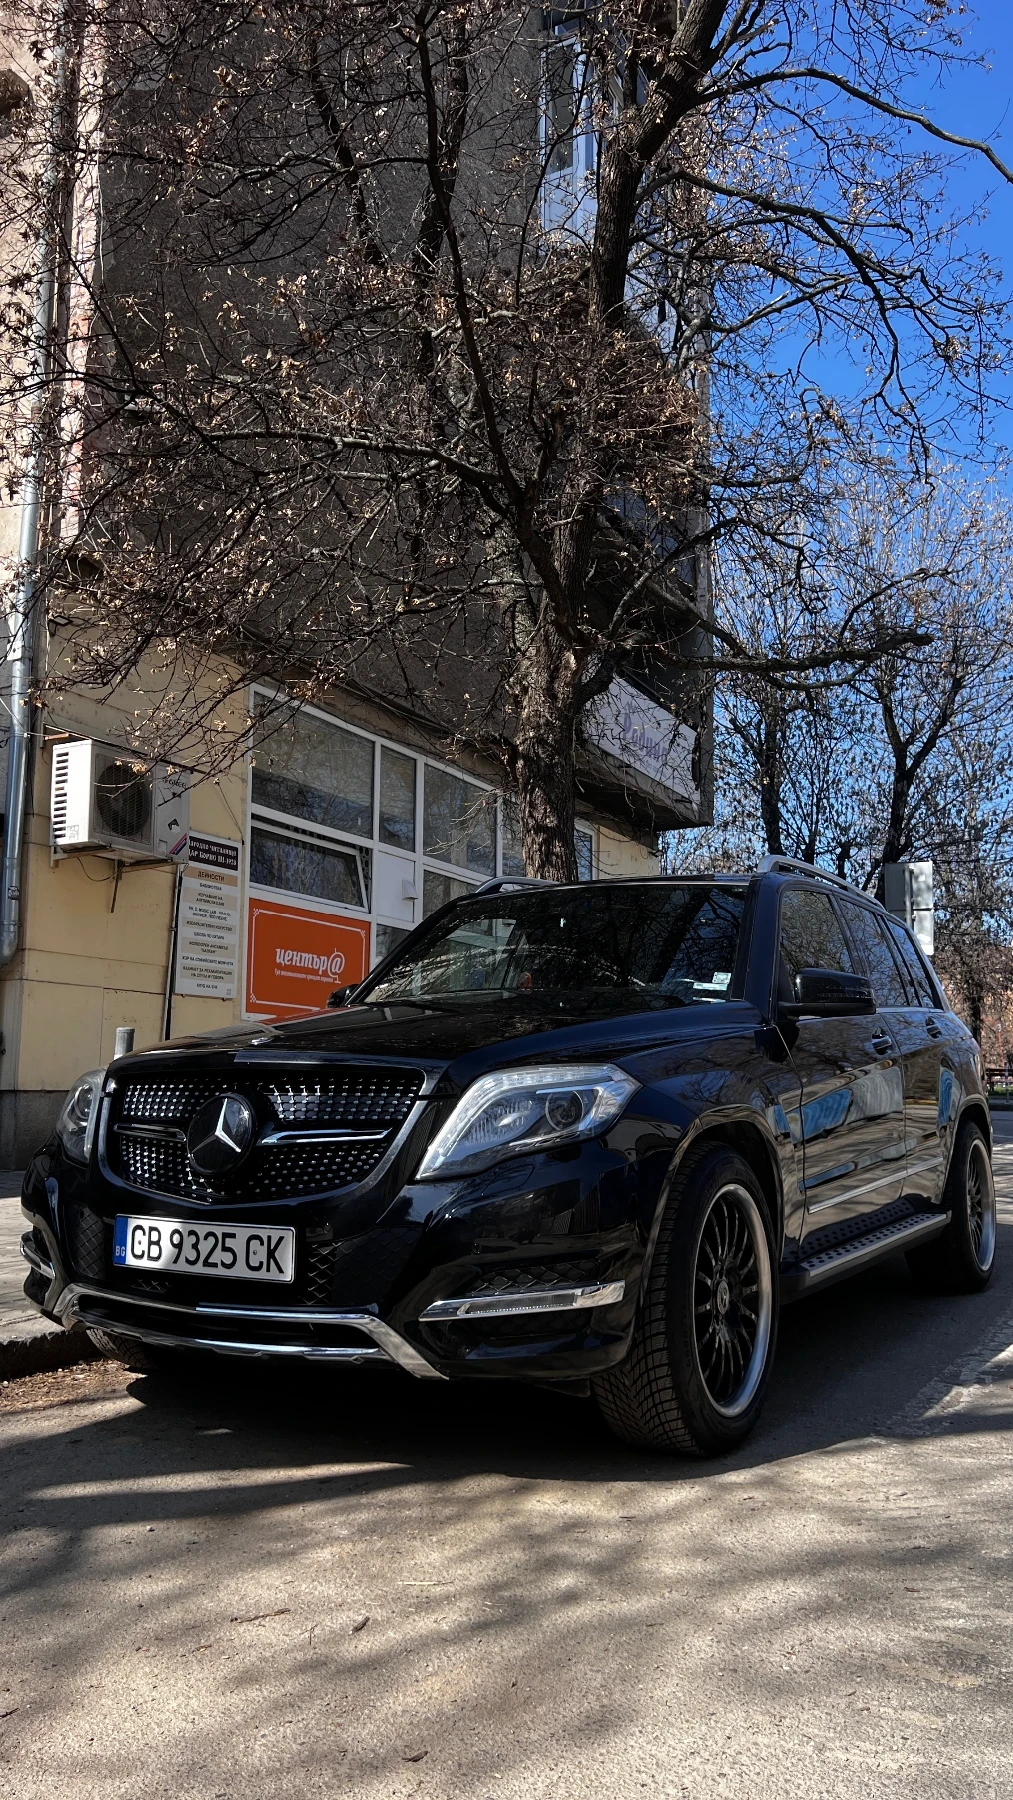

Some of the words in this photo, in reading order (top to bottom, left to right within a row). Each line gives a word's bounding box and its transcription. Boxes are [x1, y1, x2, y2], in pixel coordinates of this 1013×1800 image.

[197, 871, 225, 881] ДЕЙНОСТИ
[115, 1246, 126, 1257] BG
[131, 1225, 162, 1261] CB
[170, 1228, 237, 1269] 9325
[245, 1234, 285, 1274] CK
